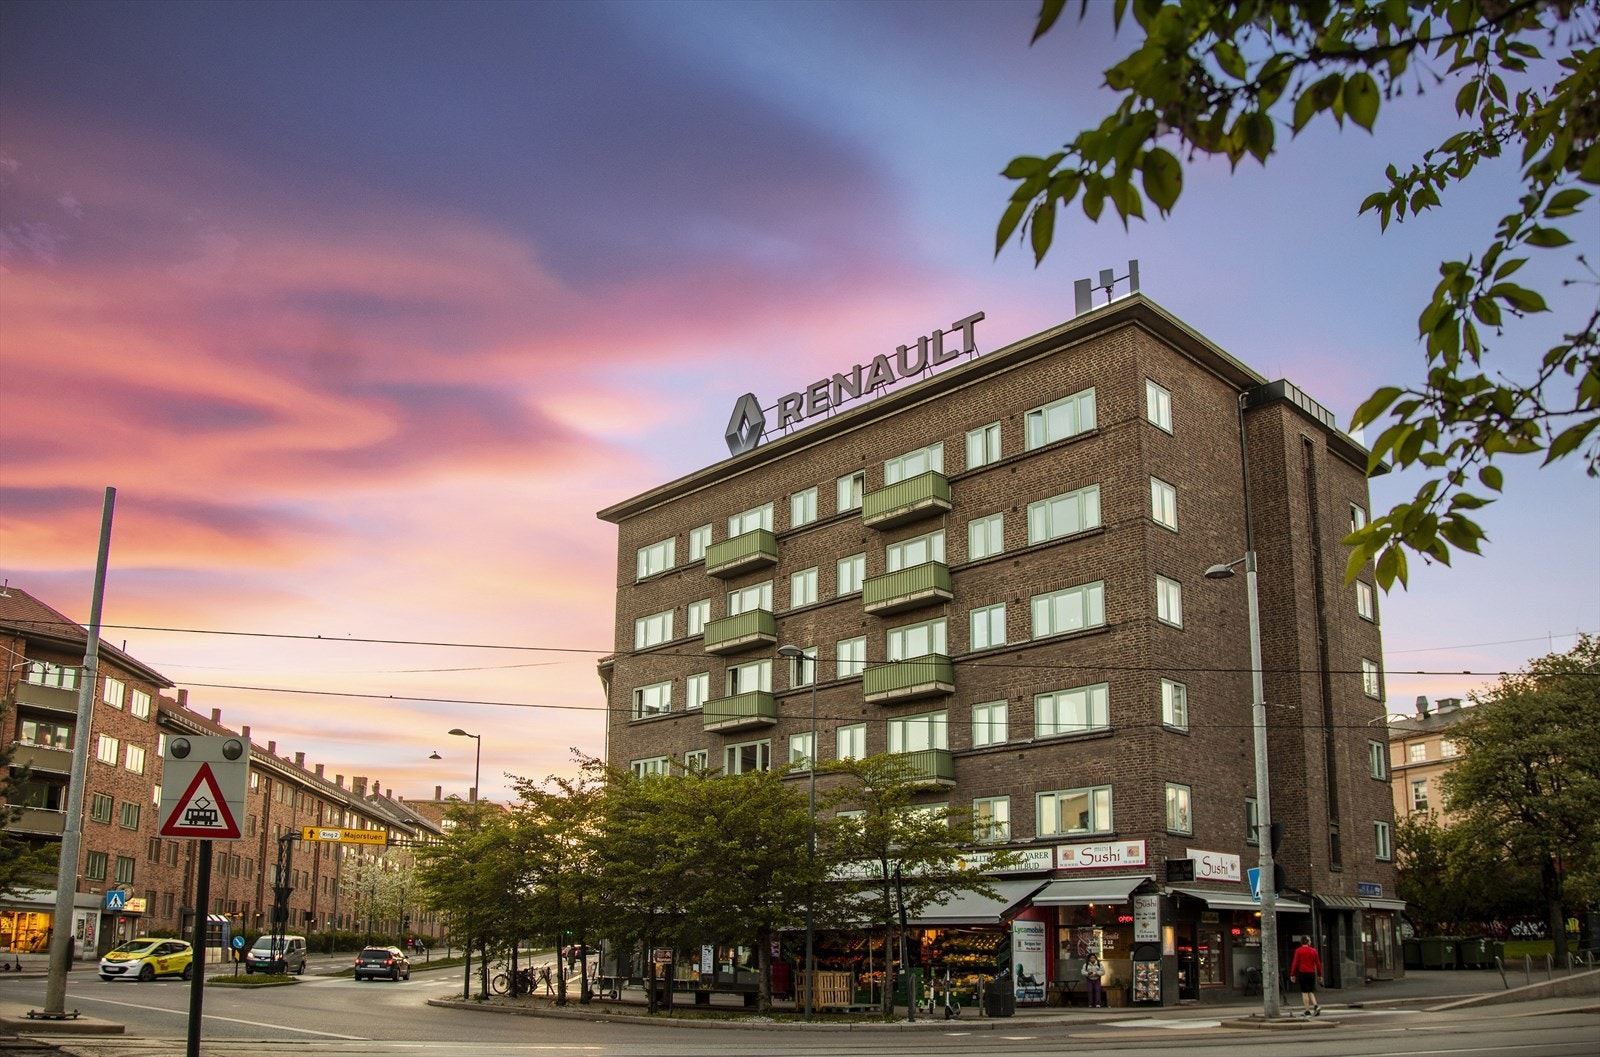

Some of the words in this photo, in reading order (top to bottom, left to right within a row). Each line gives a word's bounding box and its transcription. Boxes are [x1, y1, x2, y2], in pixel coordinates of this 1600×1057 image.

[777, 311, 985, 429] RENAULT
[344, 831, 383, 840] Majorstuen
[1025, 851, 1049, 860] VARER
[1080, 846, 1120, 866] Sushi
[1014, 862, 1040, 871] TILBUD
[1201, 855, 1229, 876] Sushi
[1135, 898, 1157, 910] Sushi
[1118, 915, 1134, 923] OPEN
[1014, 925, 1044, 935] Lycamobile
